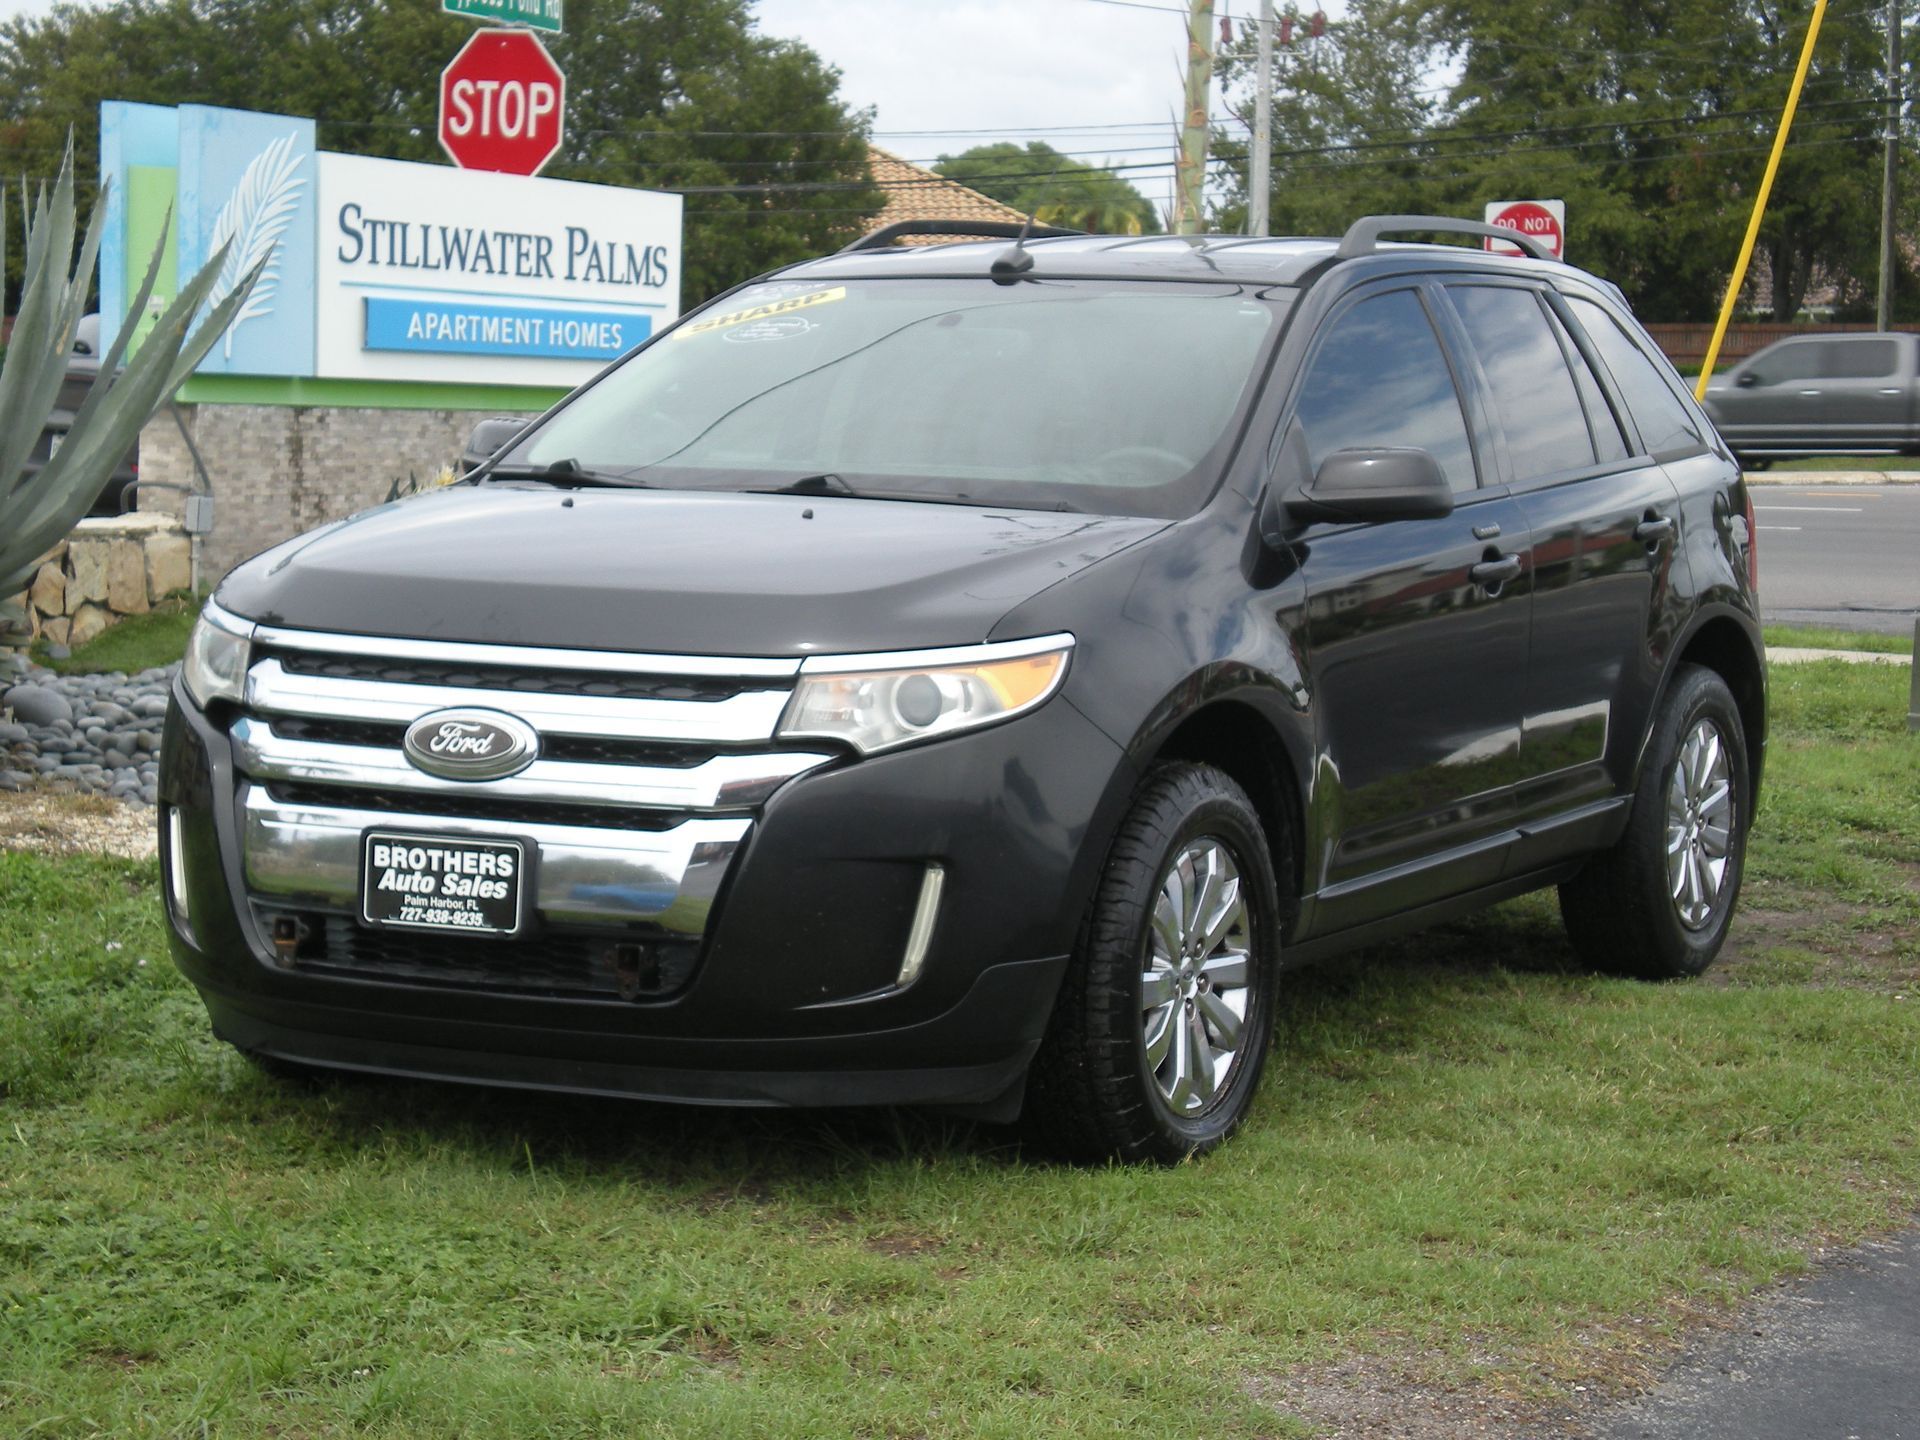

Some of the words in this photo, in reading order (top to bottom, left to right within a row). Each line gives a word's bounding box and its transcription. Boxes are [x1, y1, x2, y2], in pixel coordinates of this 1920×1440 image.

[448, 79, 555, 139] STOP
[1498, 218, 1517, 229] DO
[1524, 217, 1552, 231] NOT
[338, 202, 555, 280] STILLWATER
[564, 226, 668, 288] PALMS
[690, 292, 829, 332] SHARP
[407, 311, 544, 345] APARTMENT
[550, 319, 623, 349] HOMES
[429, 722, 495, 754] Ford
[373, 844, 514, 877] BROTHERS
[377, 868, 436, 894] Auto
[440, 872, 508, 899] Sales
[399, 906, 484, 927] 727-938-9235
[404, 894, 428, 907] Palm
[430, 896, 464, 911] Harbor,
[467, 899, 479, 911] FL
